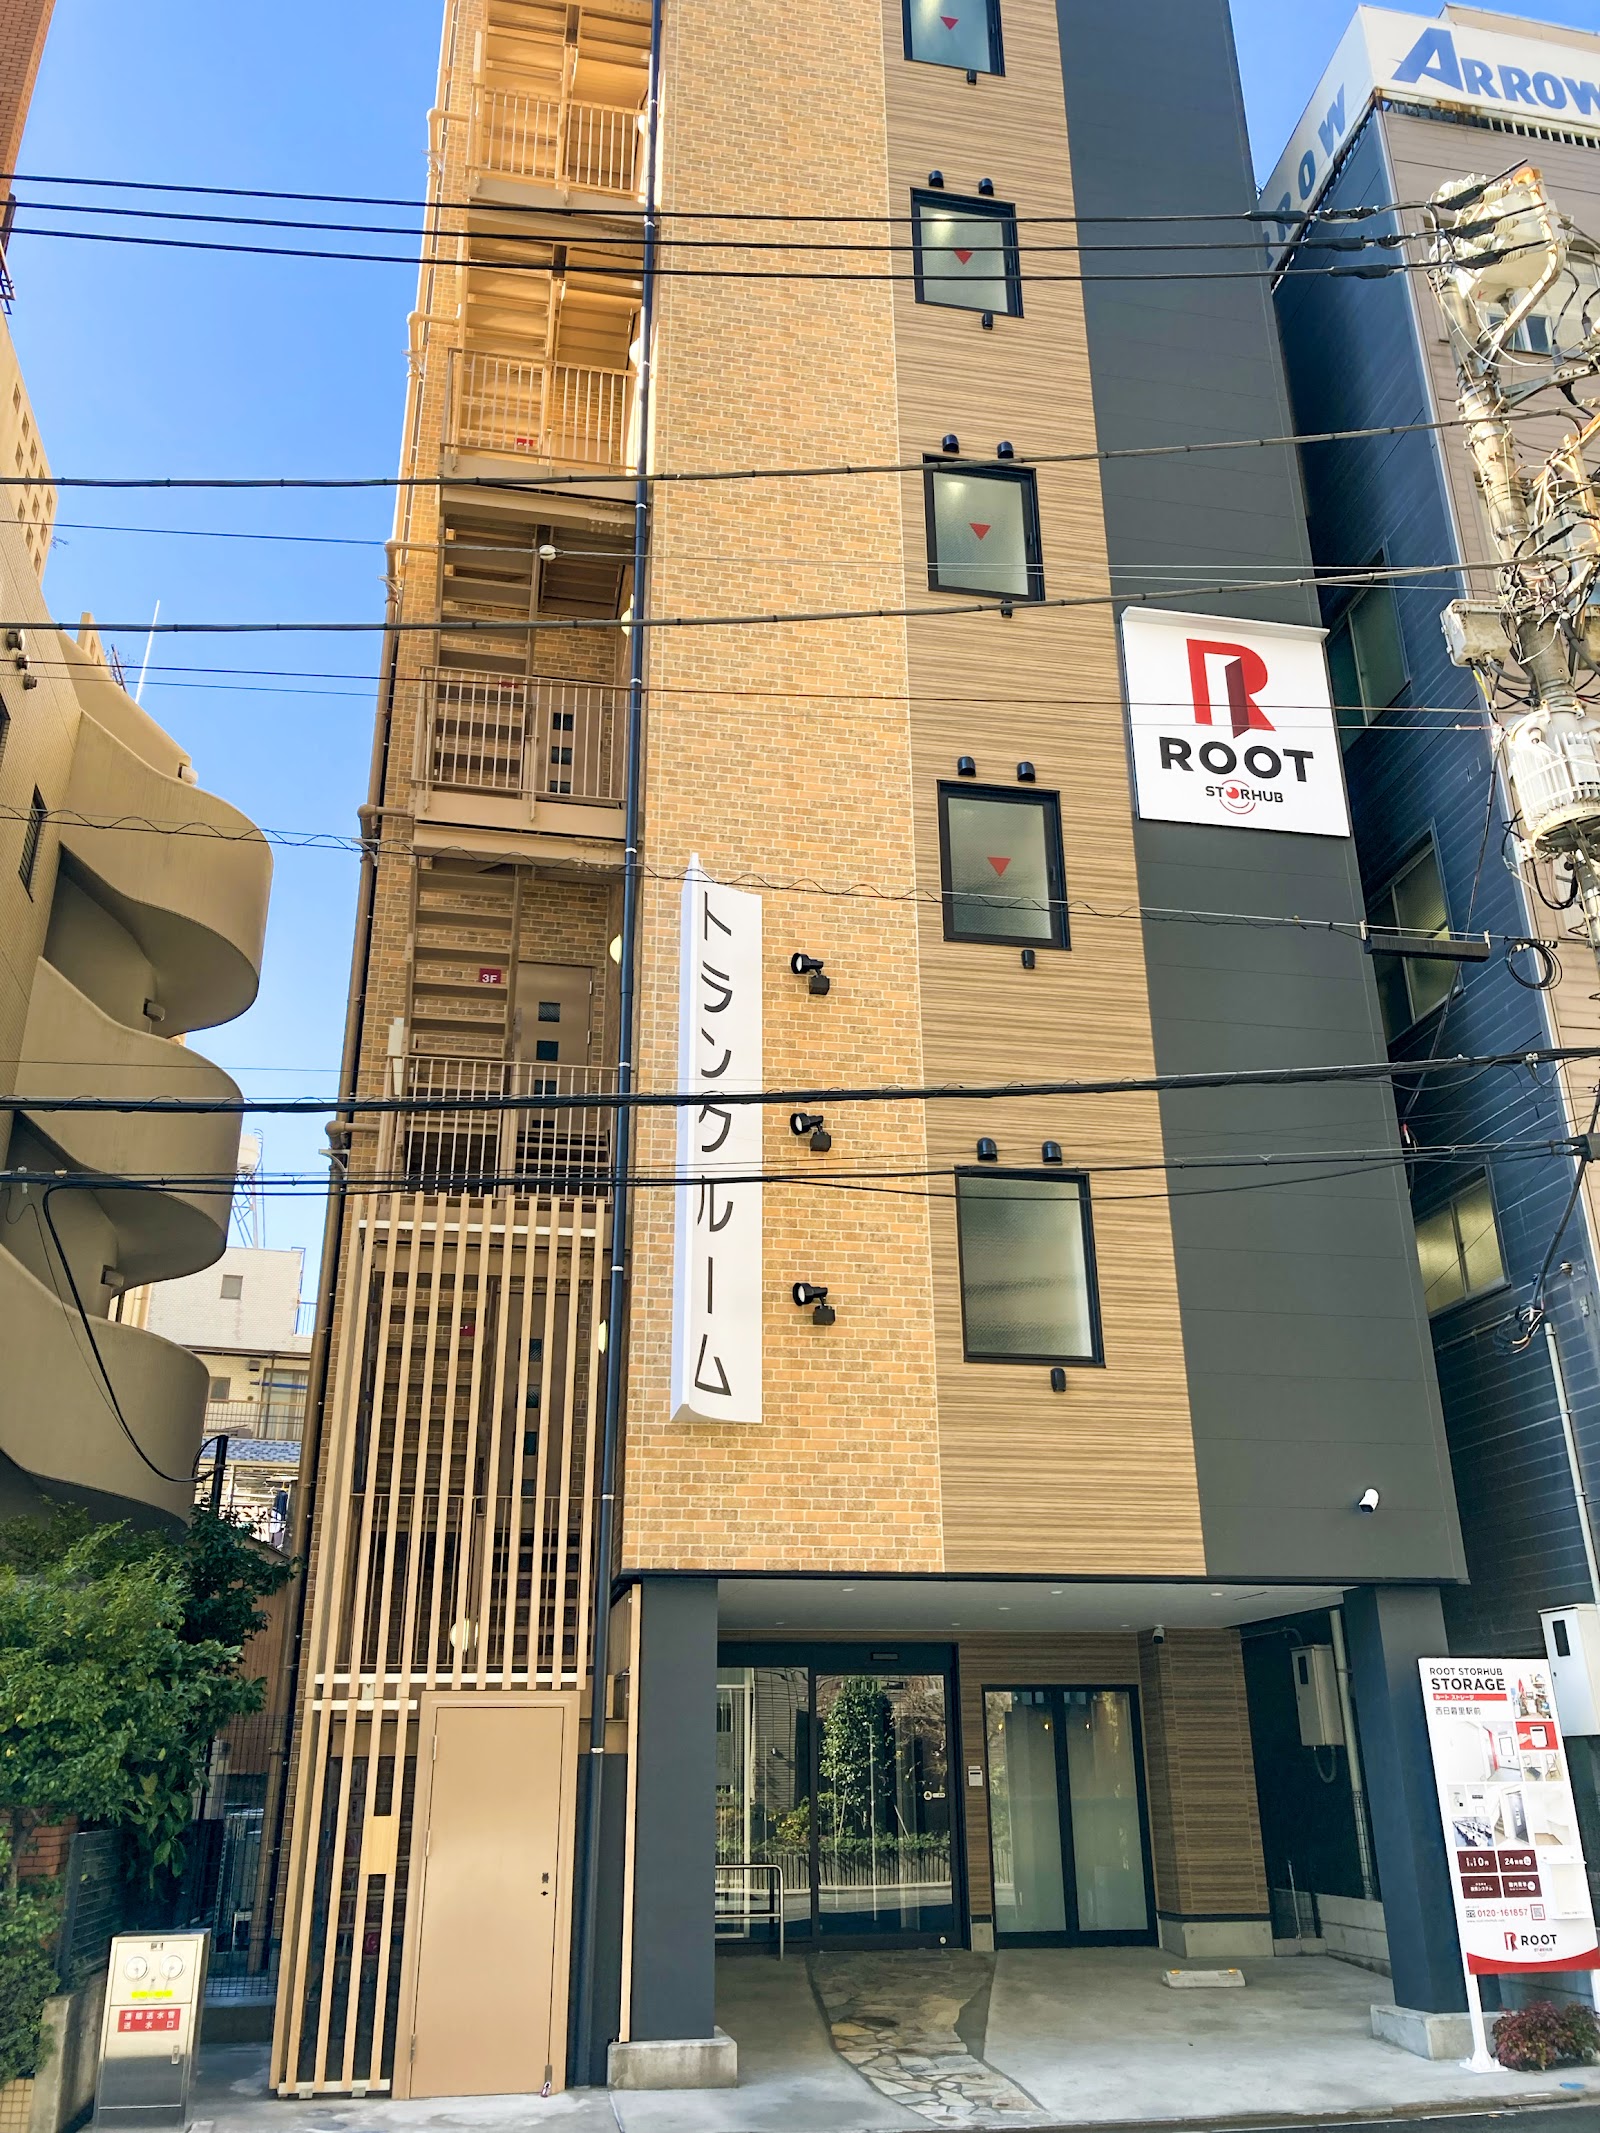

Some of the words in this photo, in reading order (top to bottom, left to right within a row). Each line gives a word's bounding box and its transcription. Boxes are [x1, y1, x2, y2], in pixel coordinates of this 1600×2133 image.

[1391, 27, 1600, 115] ARROW
[1159, 736, 1314, 782] ROOT
[1205, 785, 1284, 803] STORHUB
[482, 974, 497, 983] 3F
[695, 891, 733, 1397] トランクルーム
[1429, 1667, 1455, 1676] ROOT
[1458, 1667, 1503, 1676] STORHUB
[1431, 1678, 1506, 1691] STORAGE
[1477, 1908, 1528, 1918] 0120-161857
[1520, 1934, 1557, 1946] ROOT
